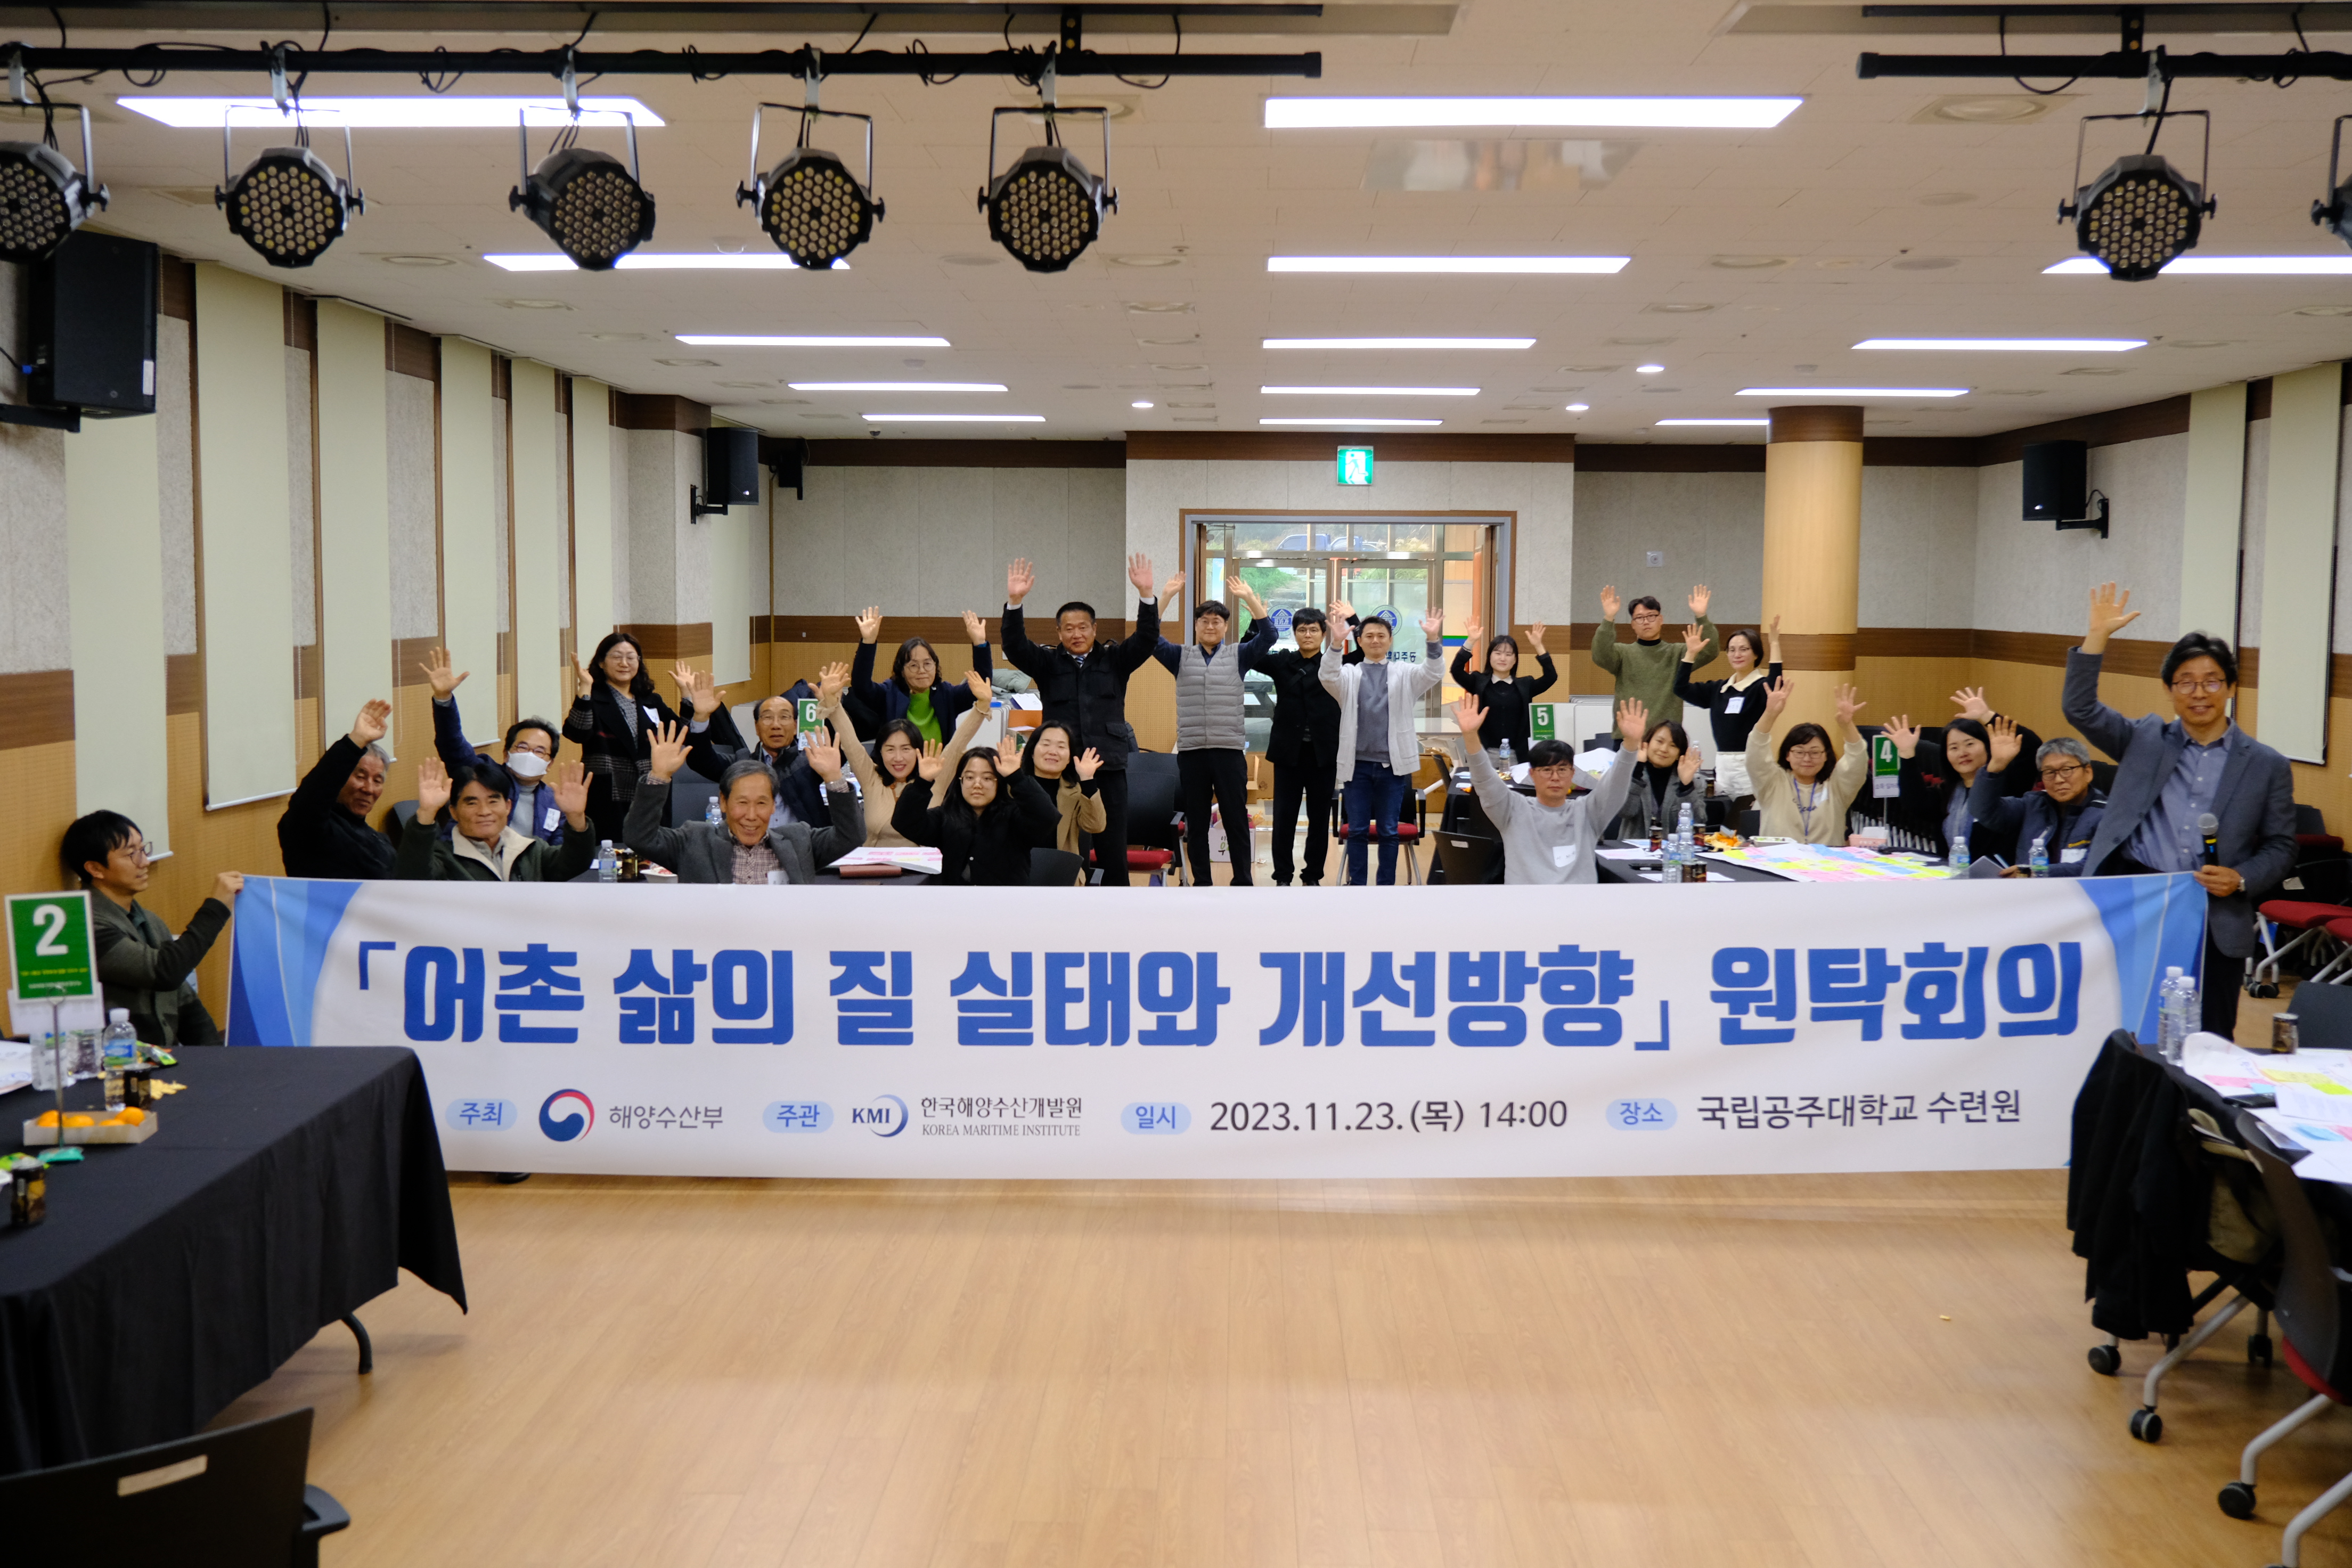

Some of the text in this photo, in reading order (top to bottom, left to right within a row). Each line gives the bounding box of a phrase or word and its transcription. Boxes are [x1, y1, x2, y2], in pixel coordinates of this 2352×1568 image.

[806, 703, 817, 722] 6
[1537, 707, 1548, 725] 5
[1880, 740, 1893, 763] 4
[34, 904, 68, 956] 2
[358, 942, 2081, 1050] 「어촌 삶의 질 실태와 개선방향」 원탁회의
[460, 1103, 502, 1125] 주최
[610, 1106, 722, 1129] 해양수산부
[777, 1105, 820, 1127] 주관
[853, 1109, 889, 1123] KMI
[921, 1098, 1081, 1117] 한국해양수산개발원
[1136, 1106, 1175, 1129] 일시
[1211, 1101, 1566, 1132] 2023.11.23.(목) 14:00
[1621, 1102, 1662, 1125] 장소
[1698, 1090, 2019, 1129] 국립공주대학교 수련원
[922, 1124, 1080, 1136] KOREA MARITIME INSTITUTE
